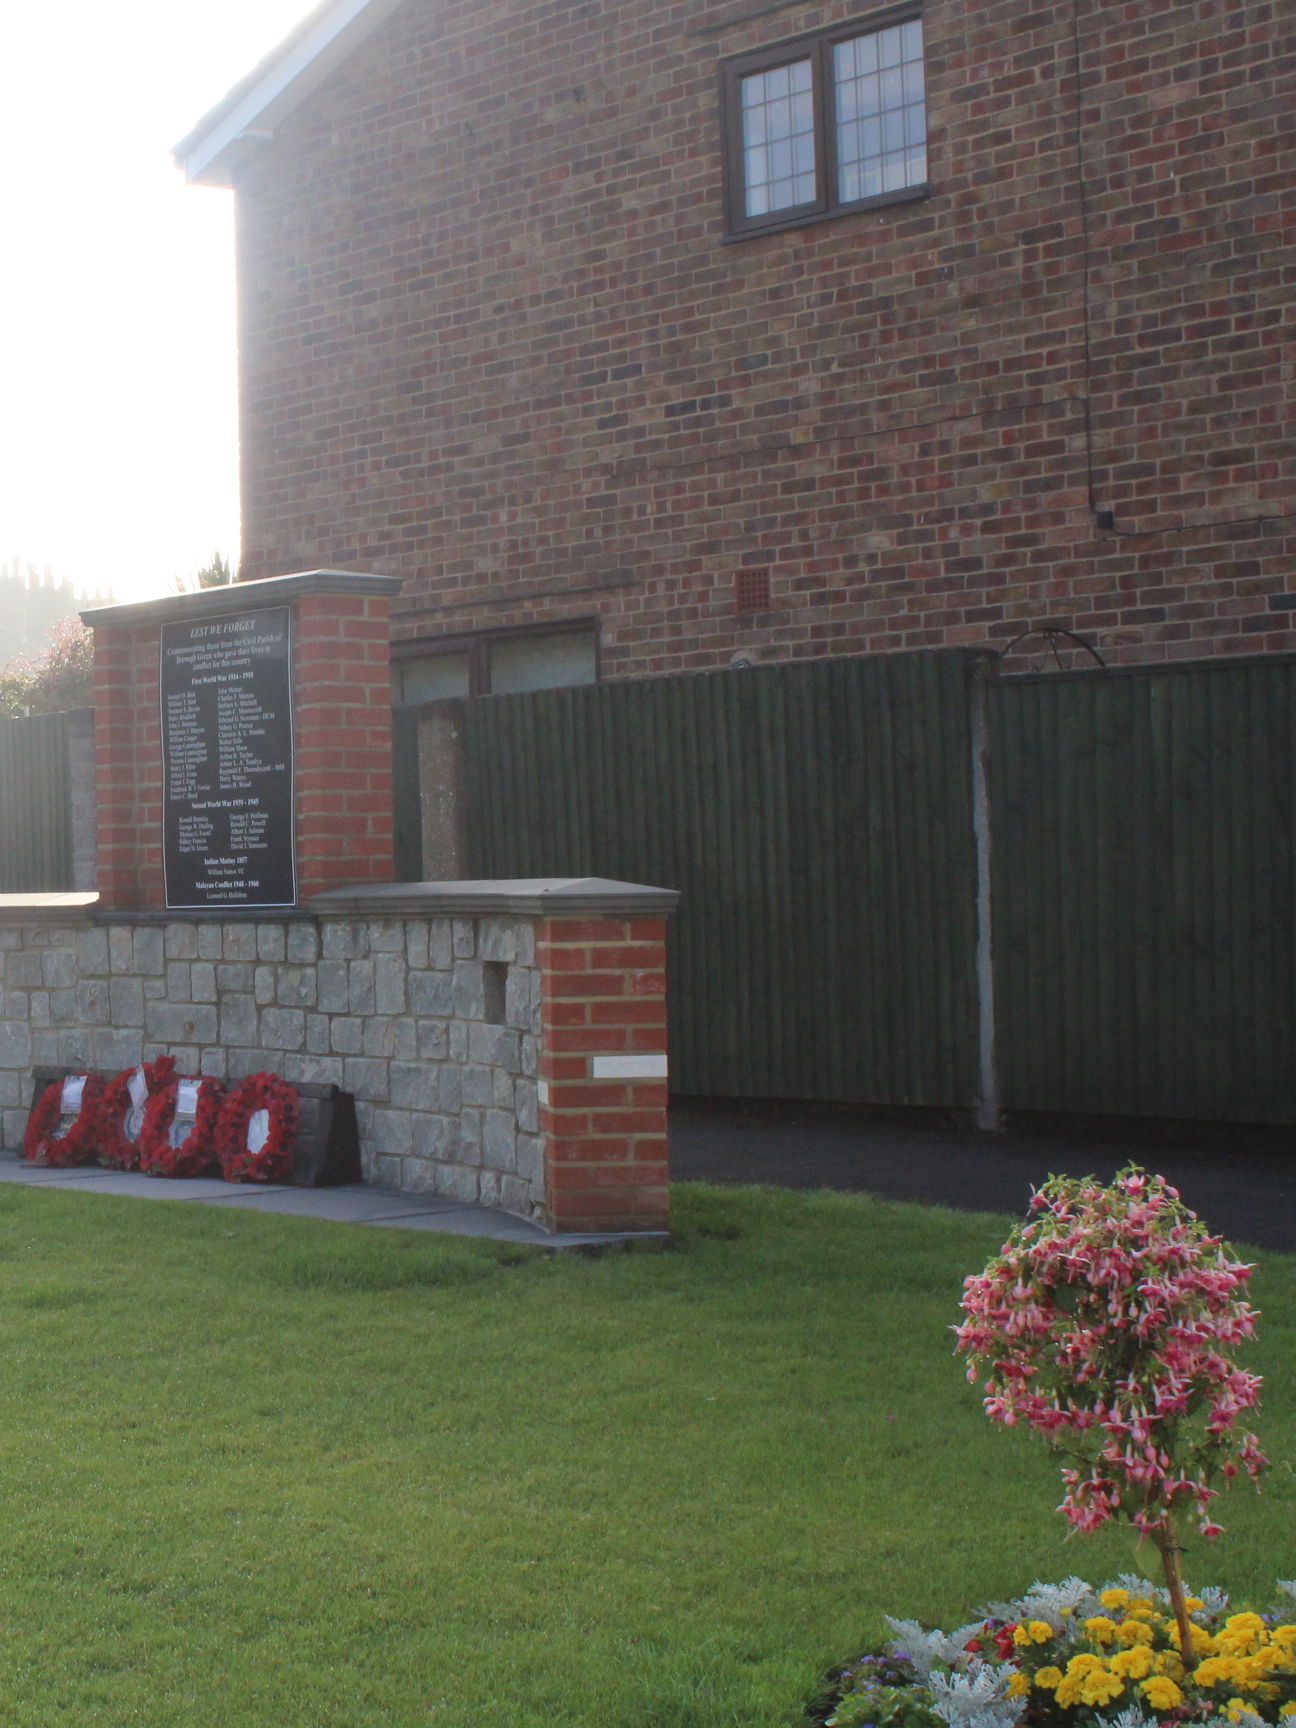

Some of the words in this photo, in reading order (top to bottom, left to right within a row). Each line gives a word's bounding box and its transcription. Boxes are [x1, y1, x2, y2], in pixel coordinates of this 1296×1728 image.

[190, 627, 209, 638] LEST
[210, 624, 222, 634] WE
[224, 620, 256, 633] FORGET
[243, 637, 256, 645] Civil
[258, 634, 274, 644] Parish
[177, 654, 196, 663] Borough
[225, 650, 236, 659] gave
[193, 662, 211, 670] conflict
[232, 658, 250, 666] country
[192, 677, 202, 685] First
[196, 882, 214, 890] Malayan
